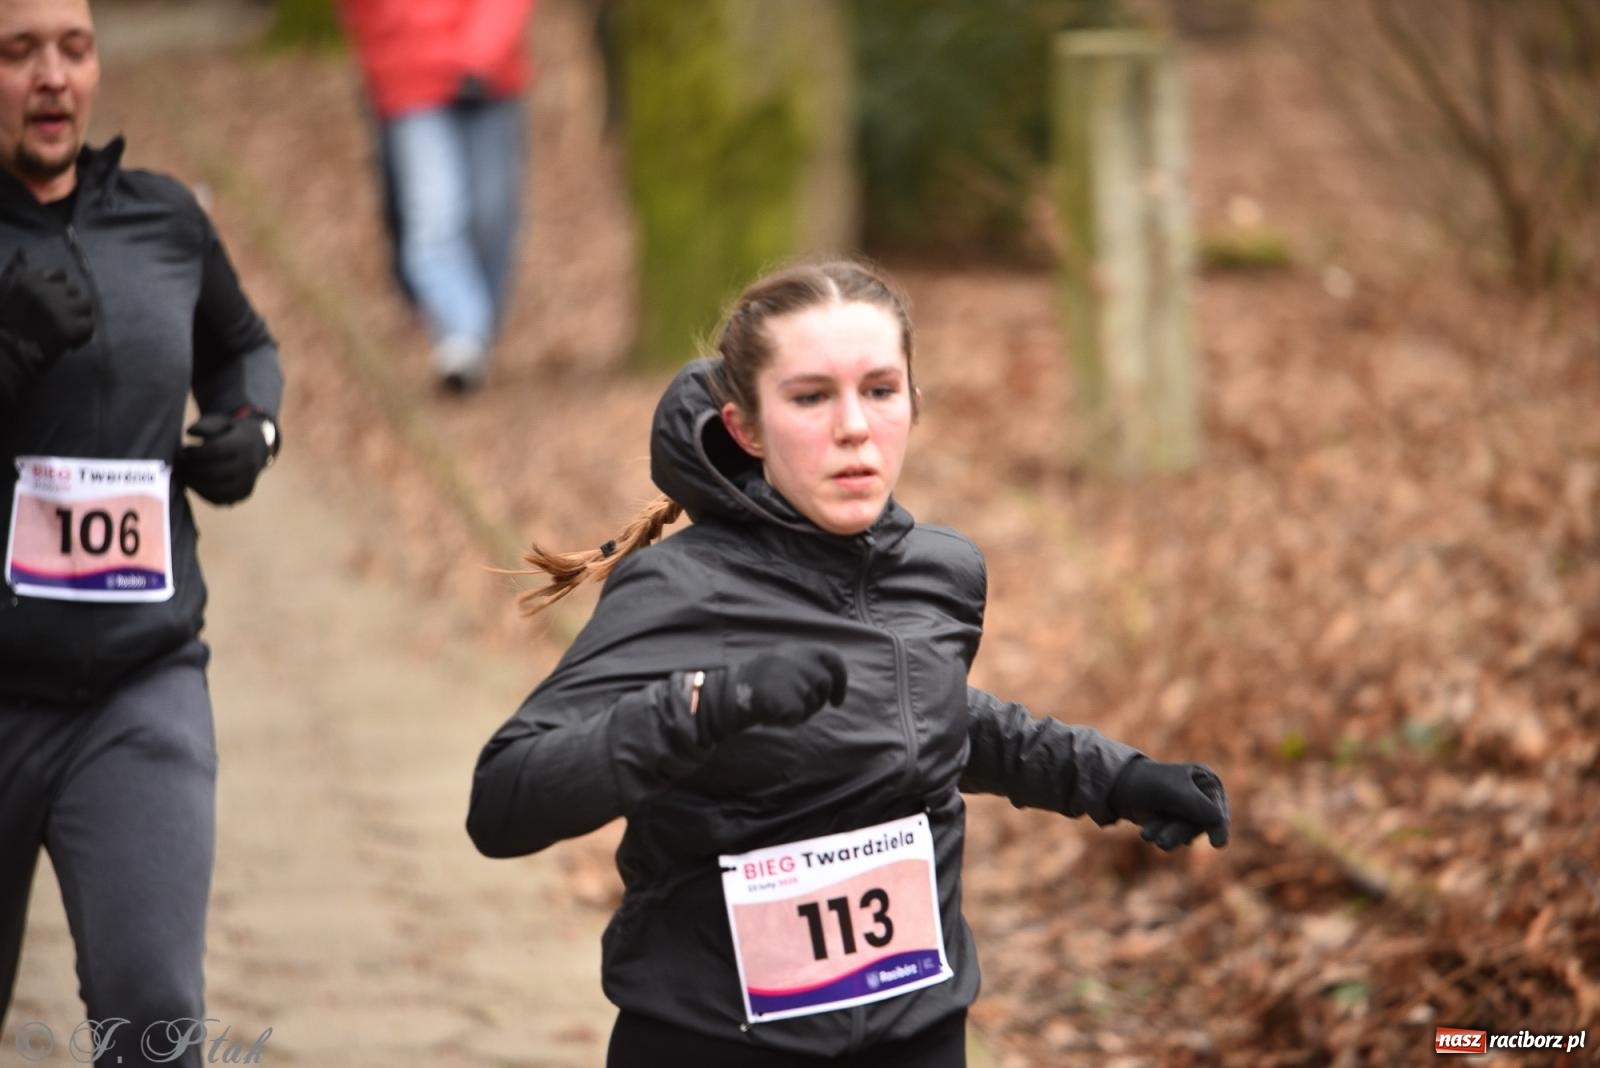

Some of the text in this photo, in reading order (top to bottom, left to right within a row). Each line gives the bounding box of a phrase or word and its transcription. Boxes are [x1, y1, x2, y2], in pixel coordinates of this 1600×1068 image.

[56, 508, 140, 556] 106
[743, 831, 915, 880] BIEG Twardziela
[797, 888, 894, 960] 113
